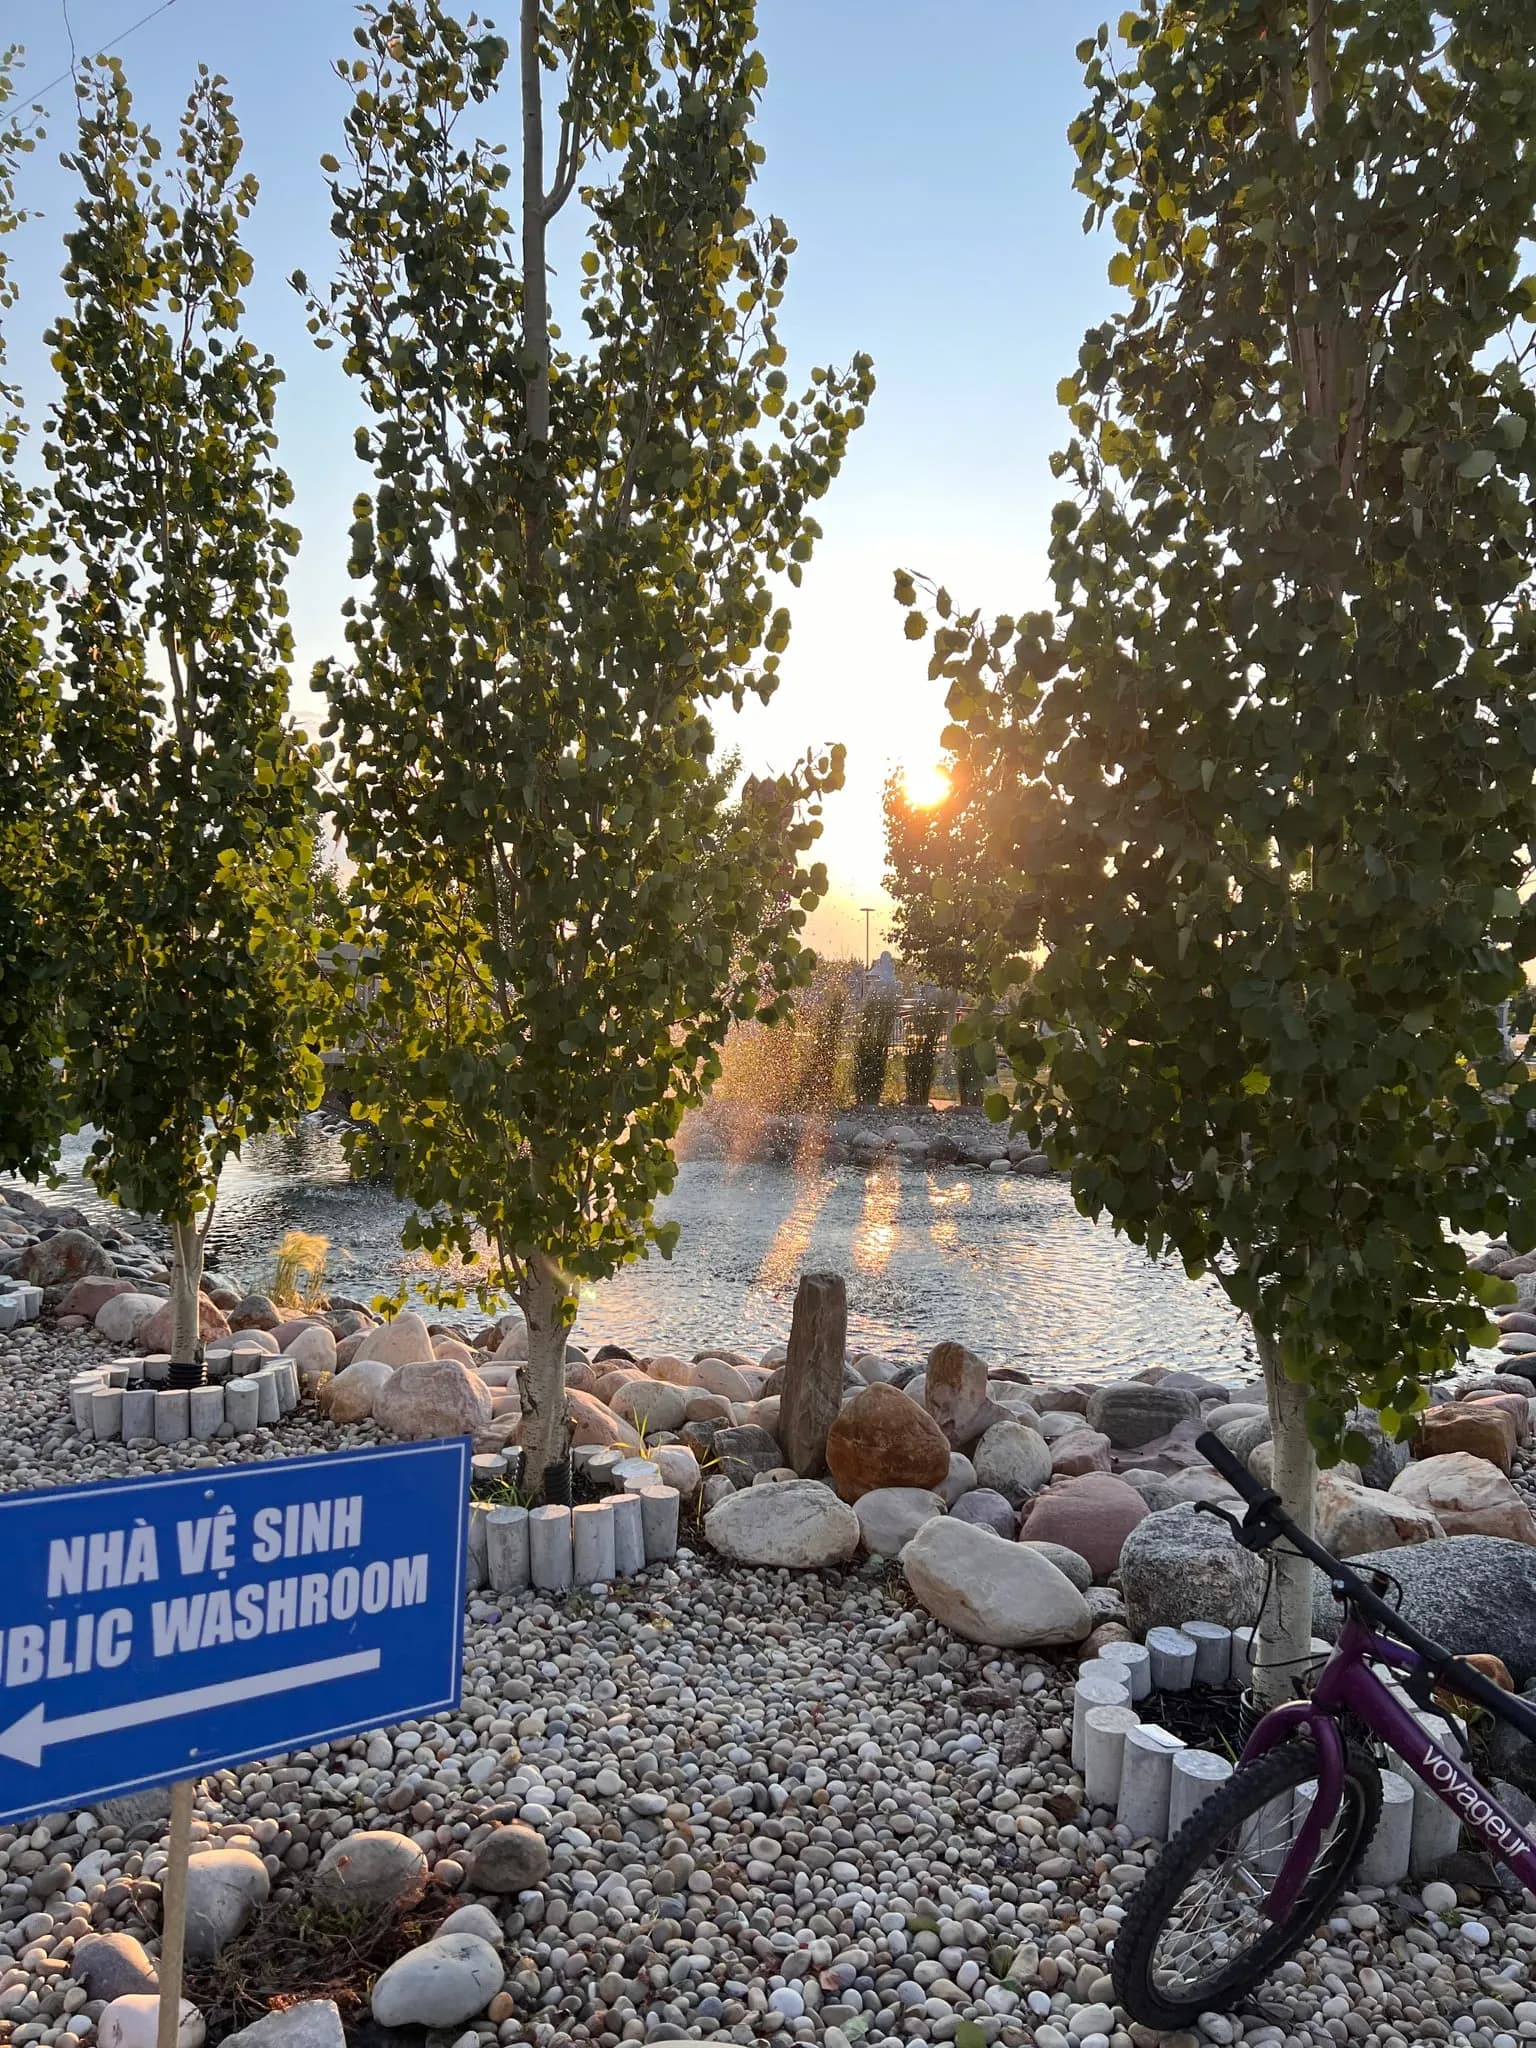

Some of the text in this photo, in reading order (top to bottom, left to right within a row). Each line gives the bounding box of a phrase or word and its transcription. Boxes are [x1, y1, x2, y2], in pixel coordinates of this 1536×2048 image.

[47, 1495, 363, 1598] NHÀ VỆ SINH
[0, 1553, 429, 1688] BLIC WASHROOM
[1422, 1744, 1531, 1857] voyageur
